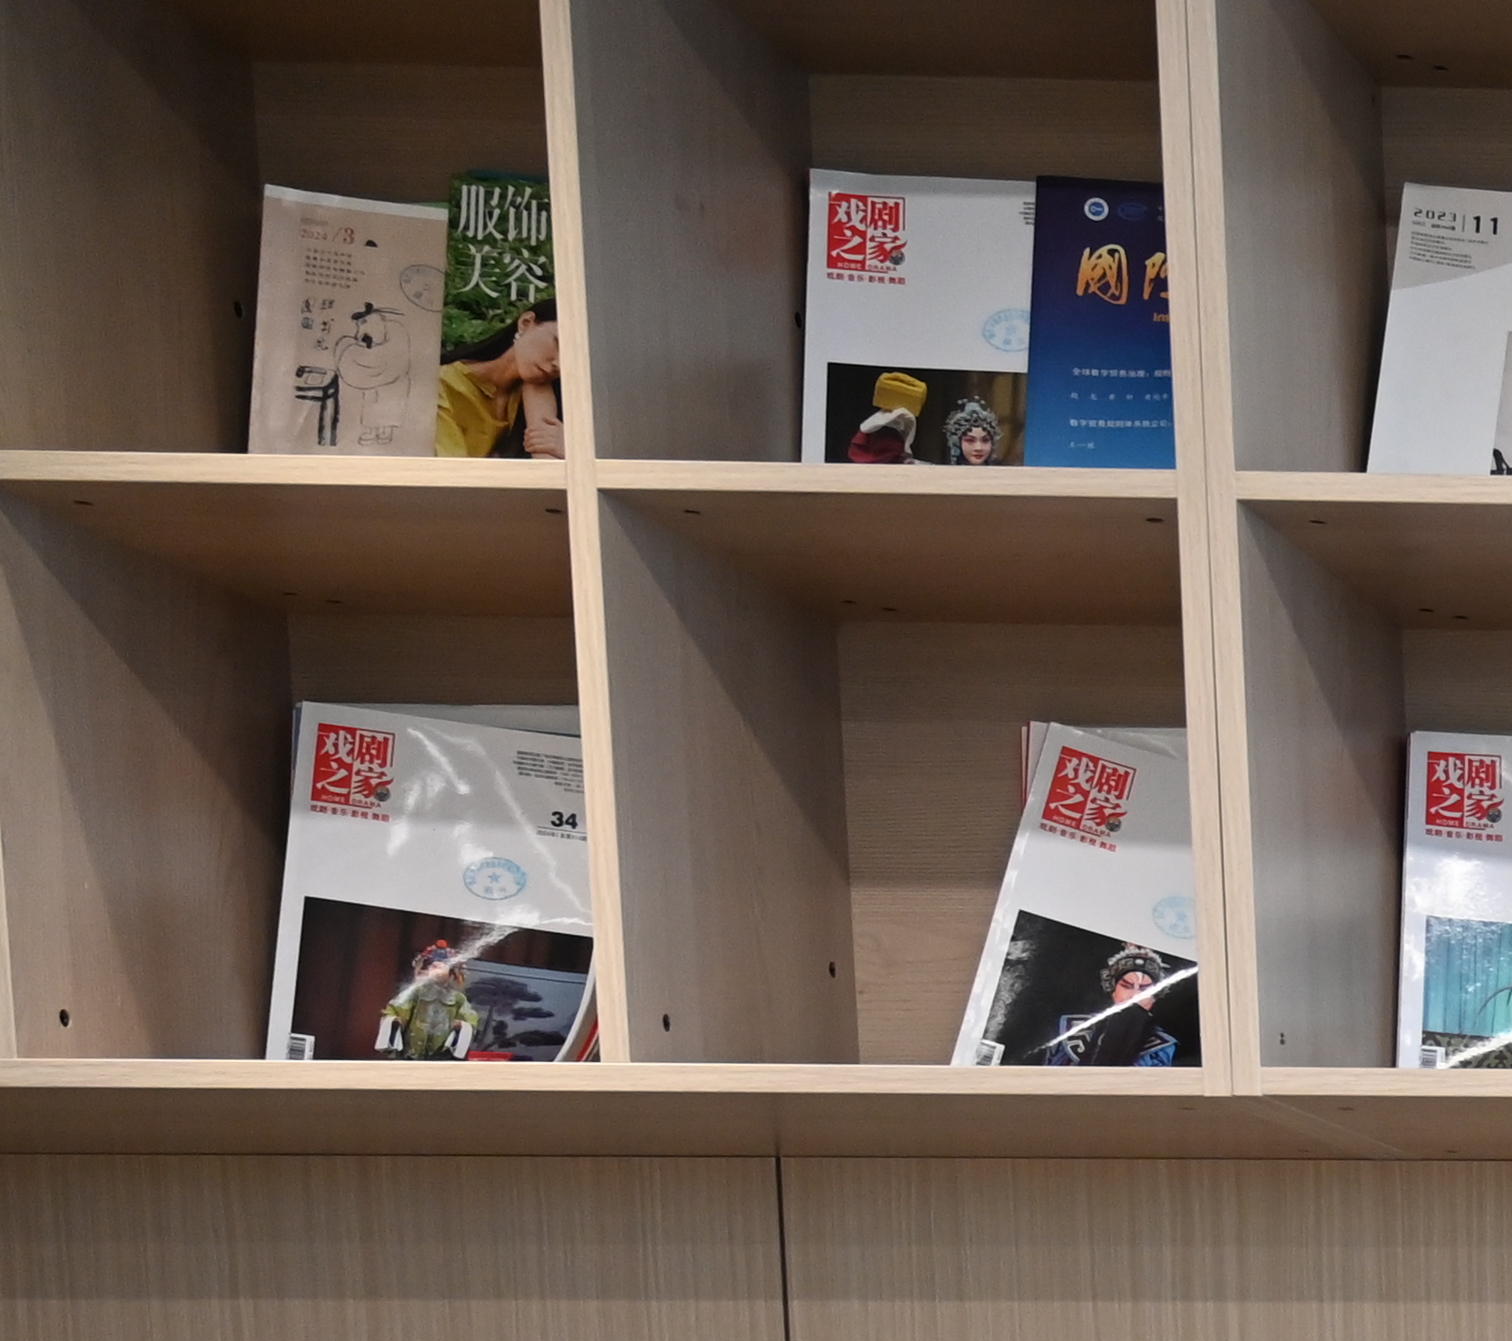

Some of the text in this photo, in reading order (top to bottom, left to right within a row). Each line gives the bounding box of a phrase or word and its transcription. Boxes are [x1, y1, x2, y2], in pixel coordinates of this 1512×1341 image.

[458, 185, 551, 246] 服饰
[459, 244, 547, 303] 美容
[550, 811, 578, 829] 34
